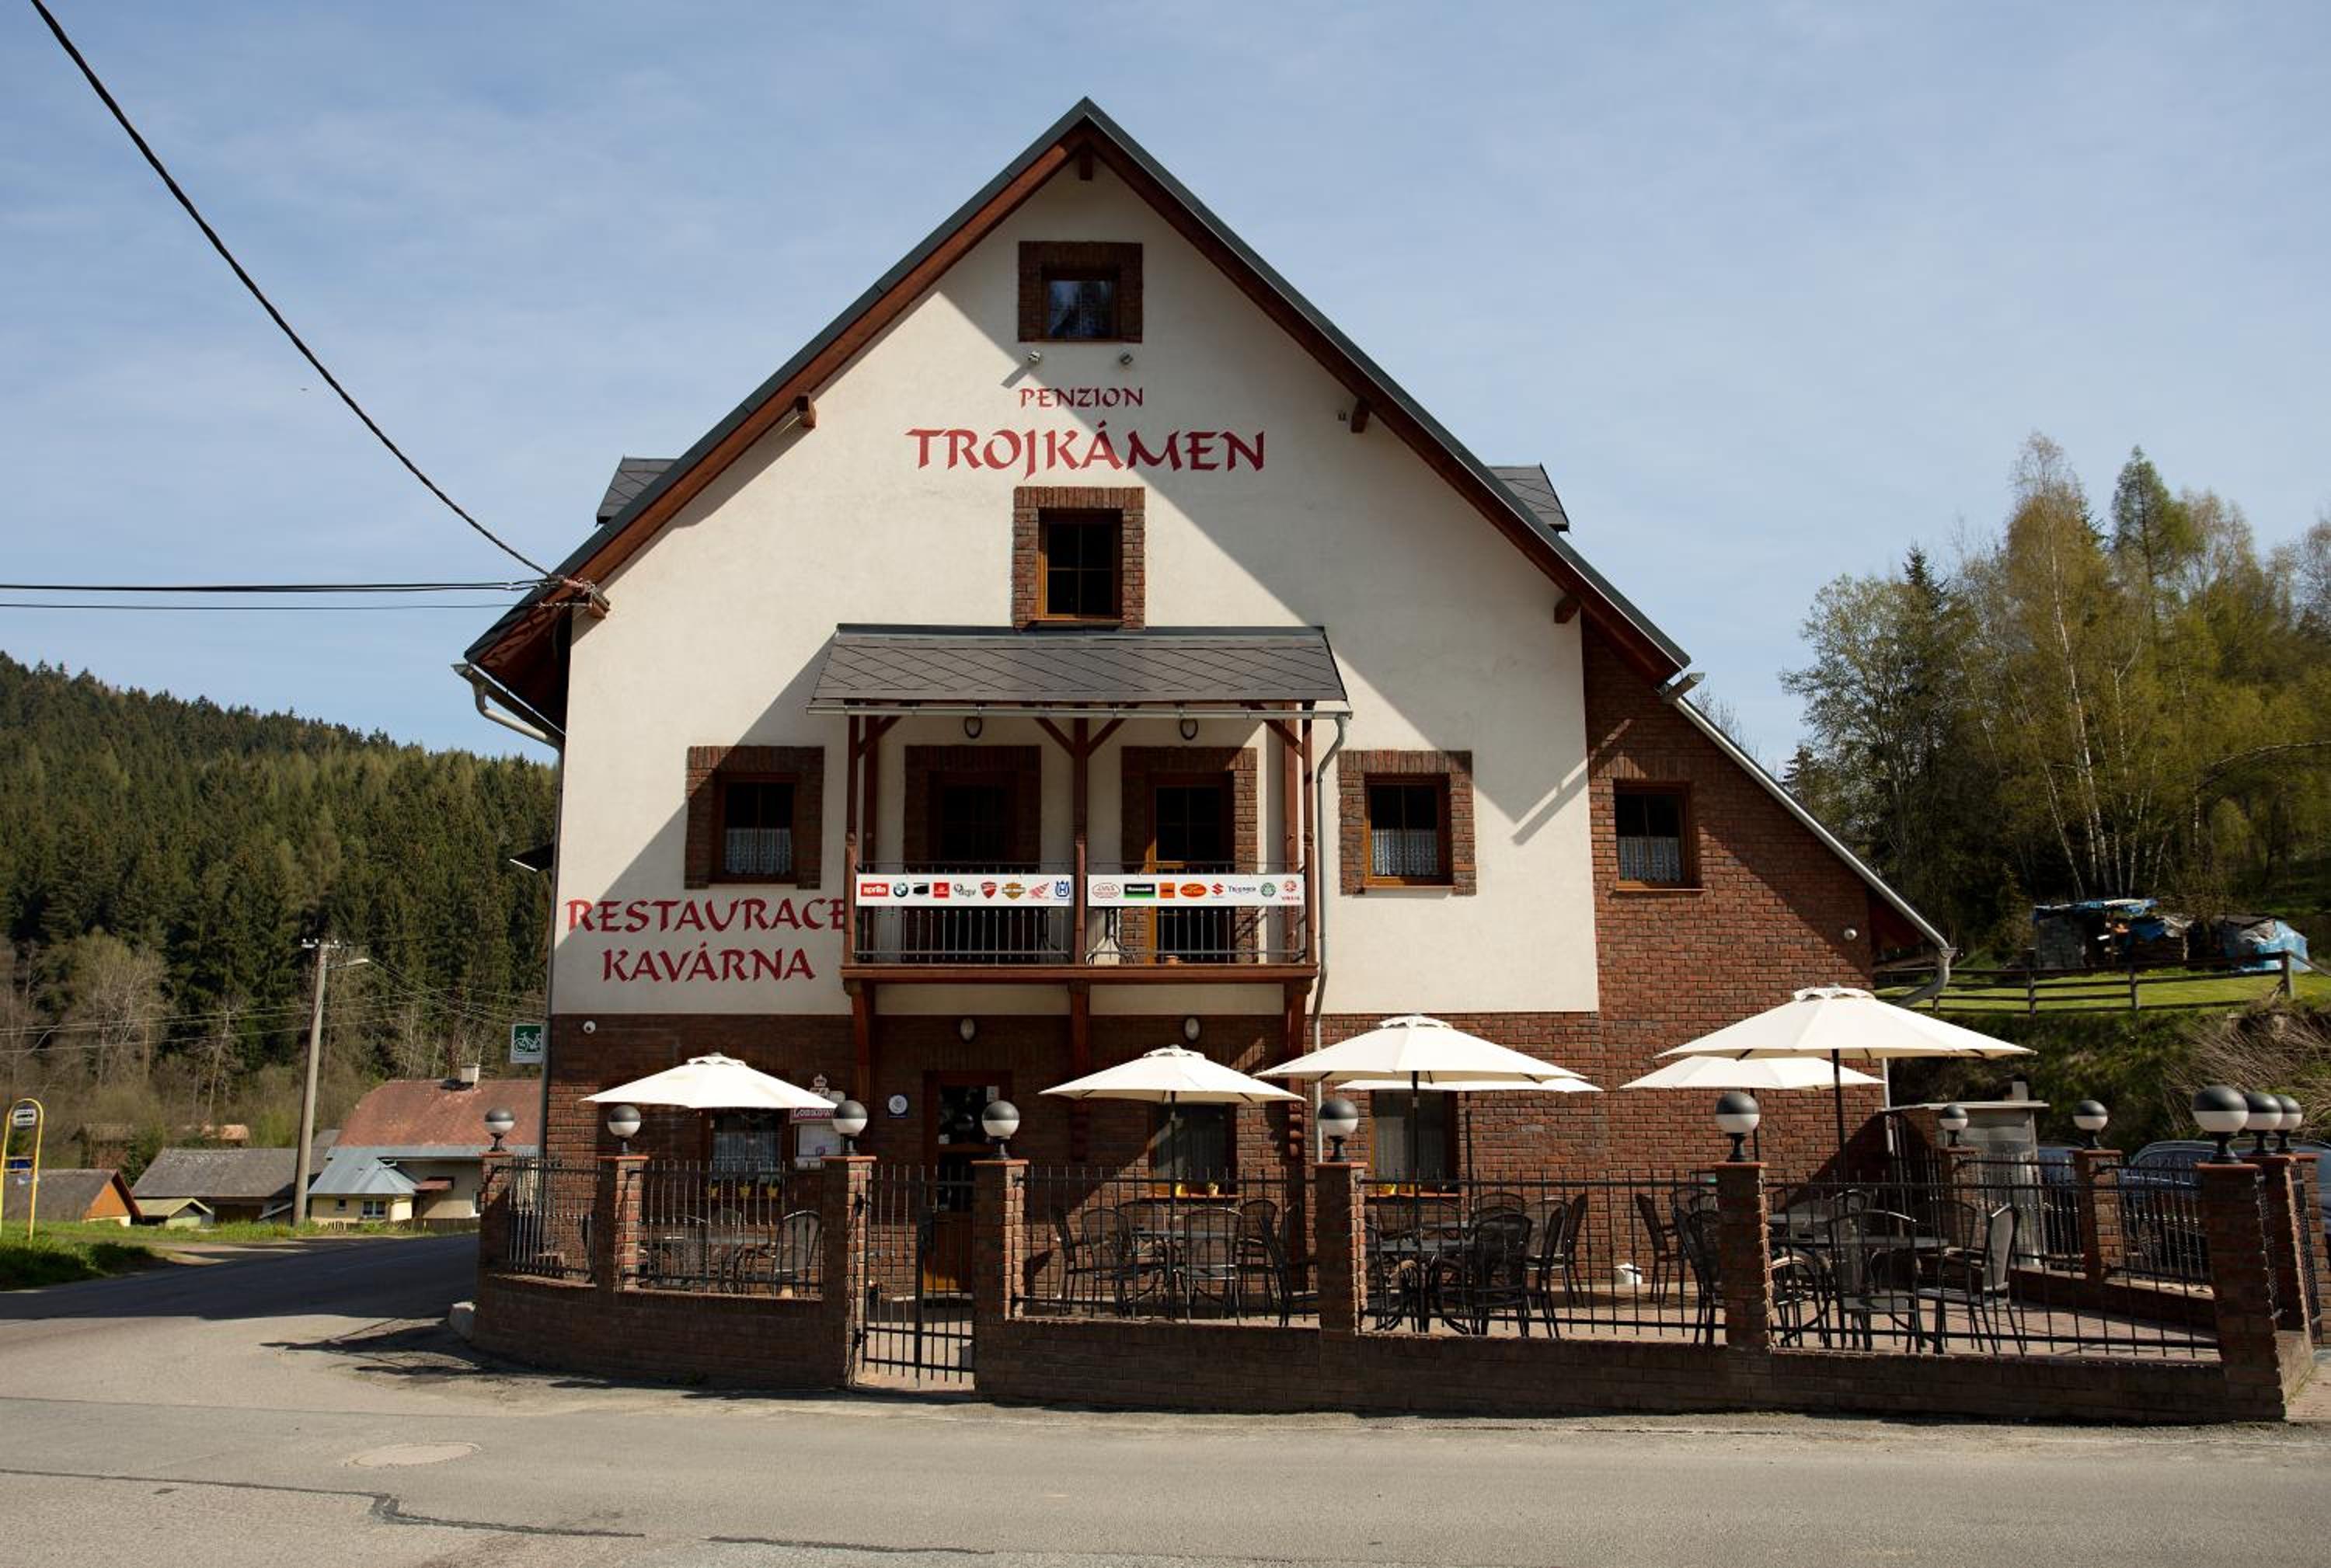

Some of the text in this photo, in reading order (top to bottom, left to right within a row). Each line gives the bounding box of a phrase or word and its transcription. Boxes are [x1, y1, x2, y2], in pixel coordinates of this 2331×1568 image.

[1019, 387, 1144, 408] PENZION
[905, 420, 1265, 479] TROJKÁMEN
[566, 897, 845, 933] RESTAURACE
[602, 942, 816, 983] KAVÁRNA
